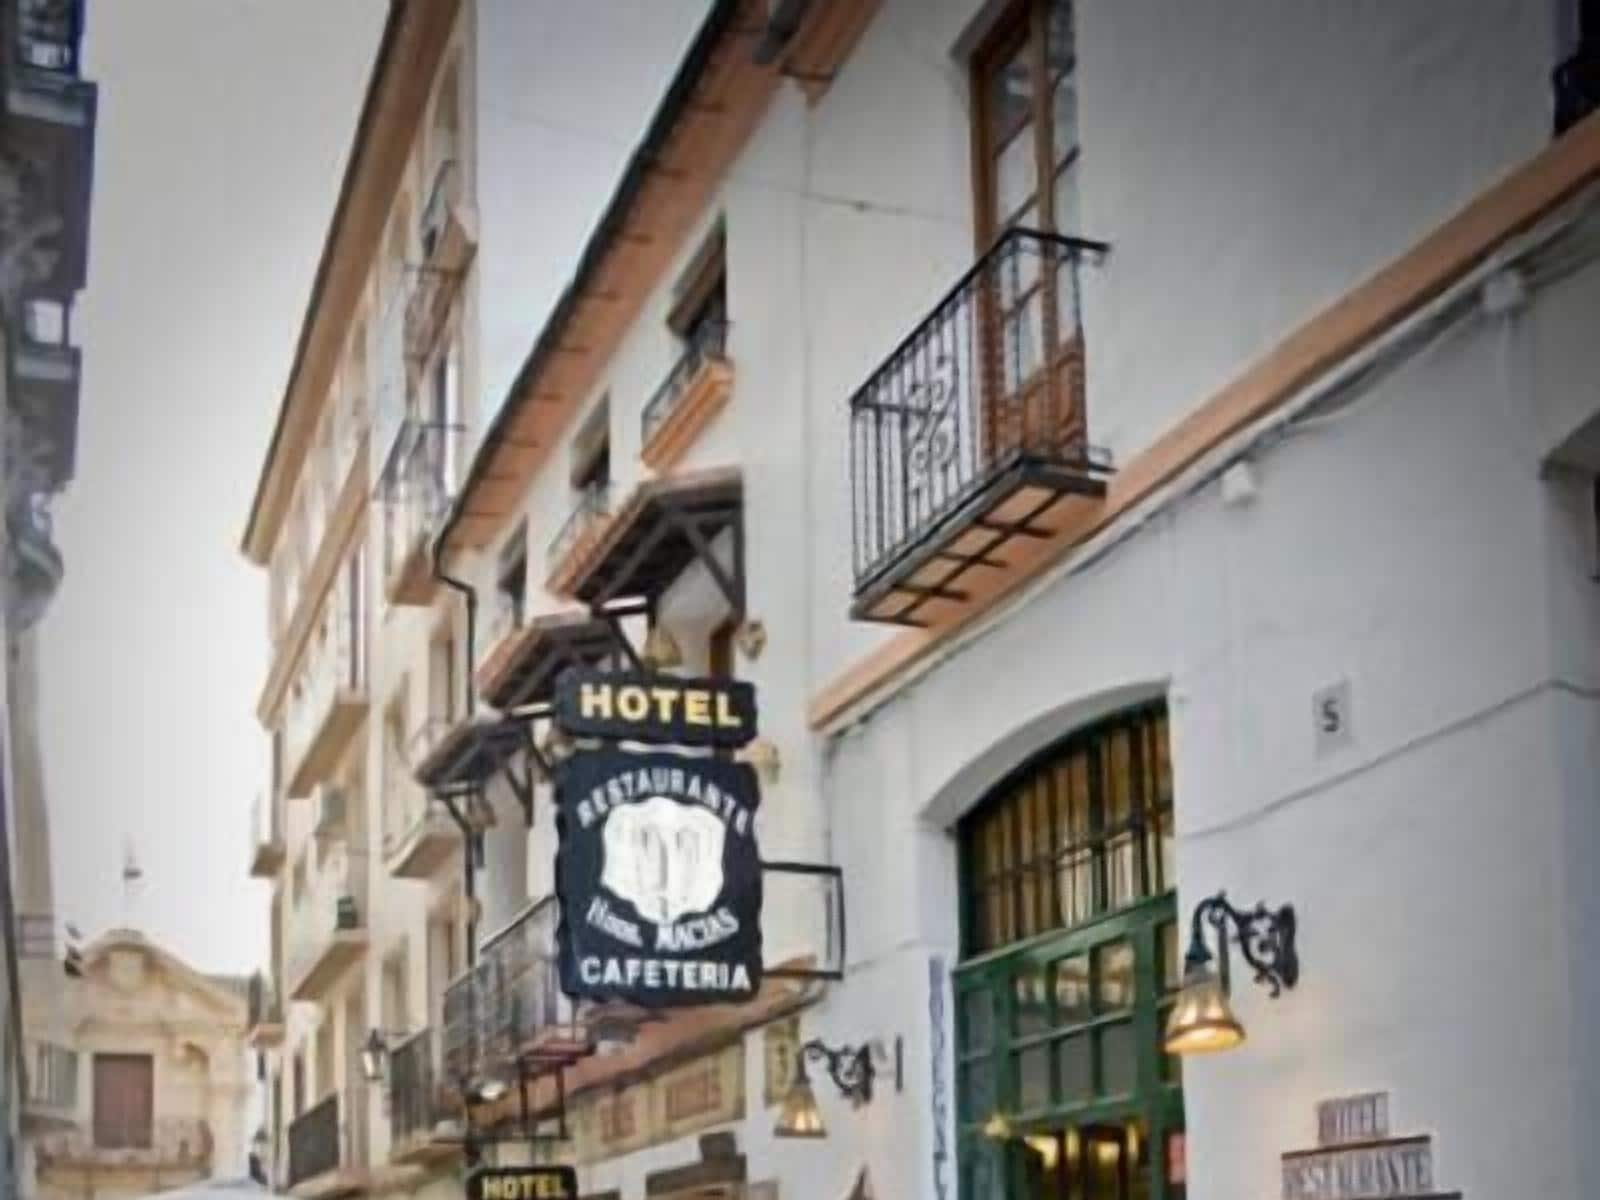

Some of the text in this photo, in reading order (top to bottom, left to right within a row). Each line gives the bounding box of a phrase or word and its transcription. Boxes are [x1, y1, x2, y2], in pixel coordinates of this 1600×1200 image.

[580, 682, 742, 727] HOTEL
[576, 767, 749, 836] RESTAURANTE
[579, 955, 750, 990] CAFETERIA
[480, 1174, 567, 1200] HOTEL
